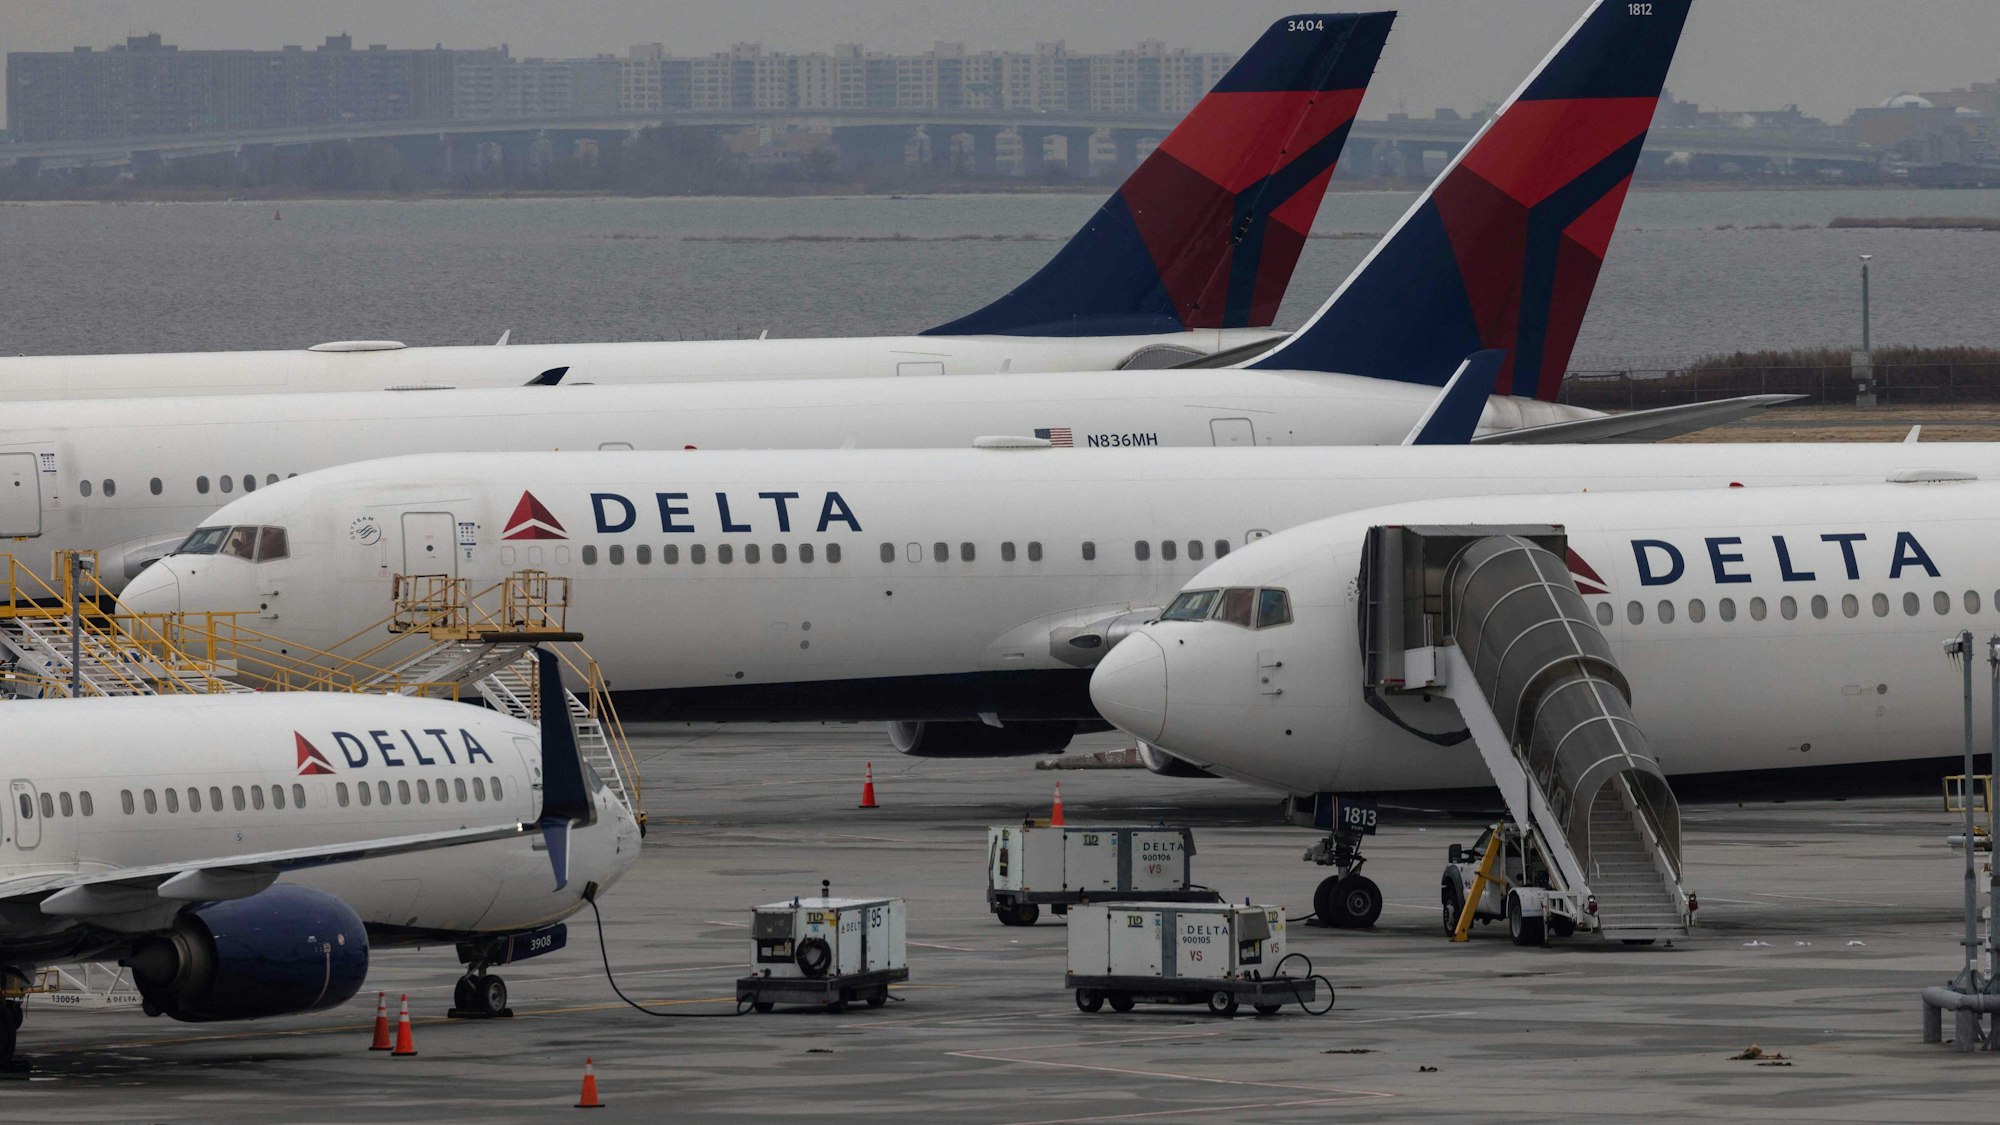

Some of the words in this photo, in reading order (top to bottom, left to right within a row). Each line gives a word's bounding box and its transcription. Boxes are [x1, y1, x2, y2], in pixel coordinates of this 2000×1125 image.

[1627, 3, 1653, 16] 1812
[1287, 20, 1324, 32] 3404
[1087, 432, 1158, 447] N836MH
[589, 490, 863, 534] DELTA
[1630, 531, 1940, 586] DELTA
[331, 728, 494, 768] DELTA
[1343, 806, 1377, 827] 1813
[1083, 834, 1099, 845] TLD
[1143, 842, 1185, 851] DELTA
[1142, 854, 1171, 862] 900106
[1149, 864, 1162, 874] VS
[806, 912, 825, 924] TLD
[871, 908, 882, 929] 95
[1127, 915, 1143, 926] TLD
[1187, 925, 1229, 936] DELTA
[530, 934, 552, 951] 3908
[1182, 936, 1211, 944] 900105
[1270, 942, 1280, 954] VS
[1189, 950, 1203, 962] VS
[51, 994, 80, 1004] 130054
[113, 995, 137, 1003] DELTA
